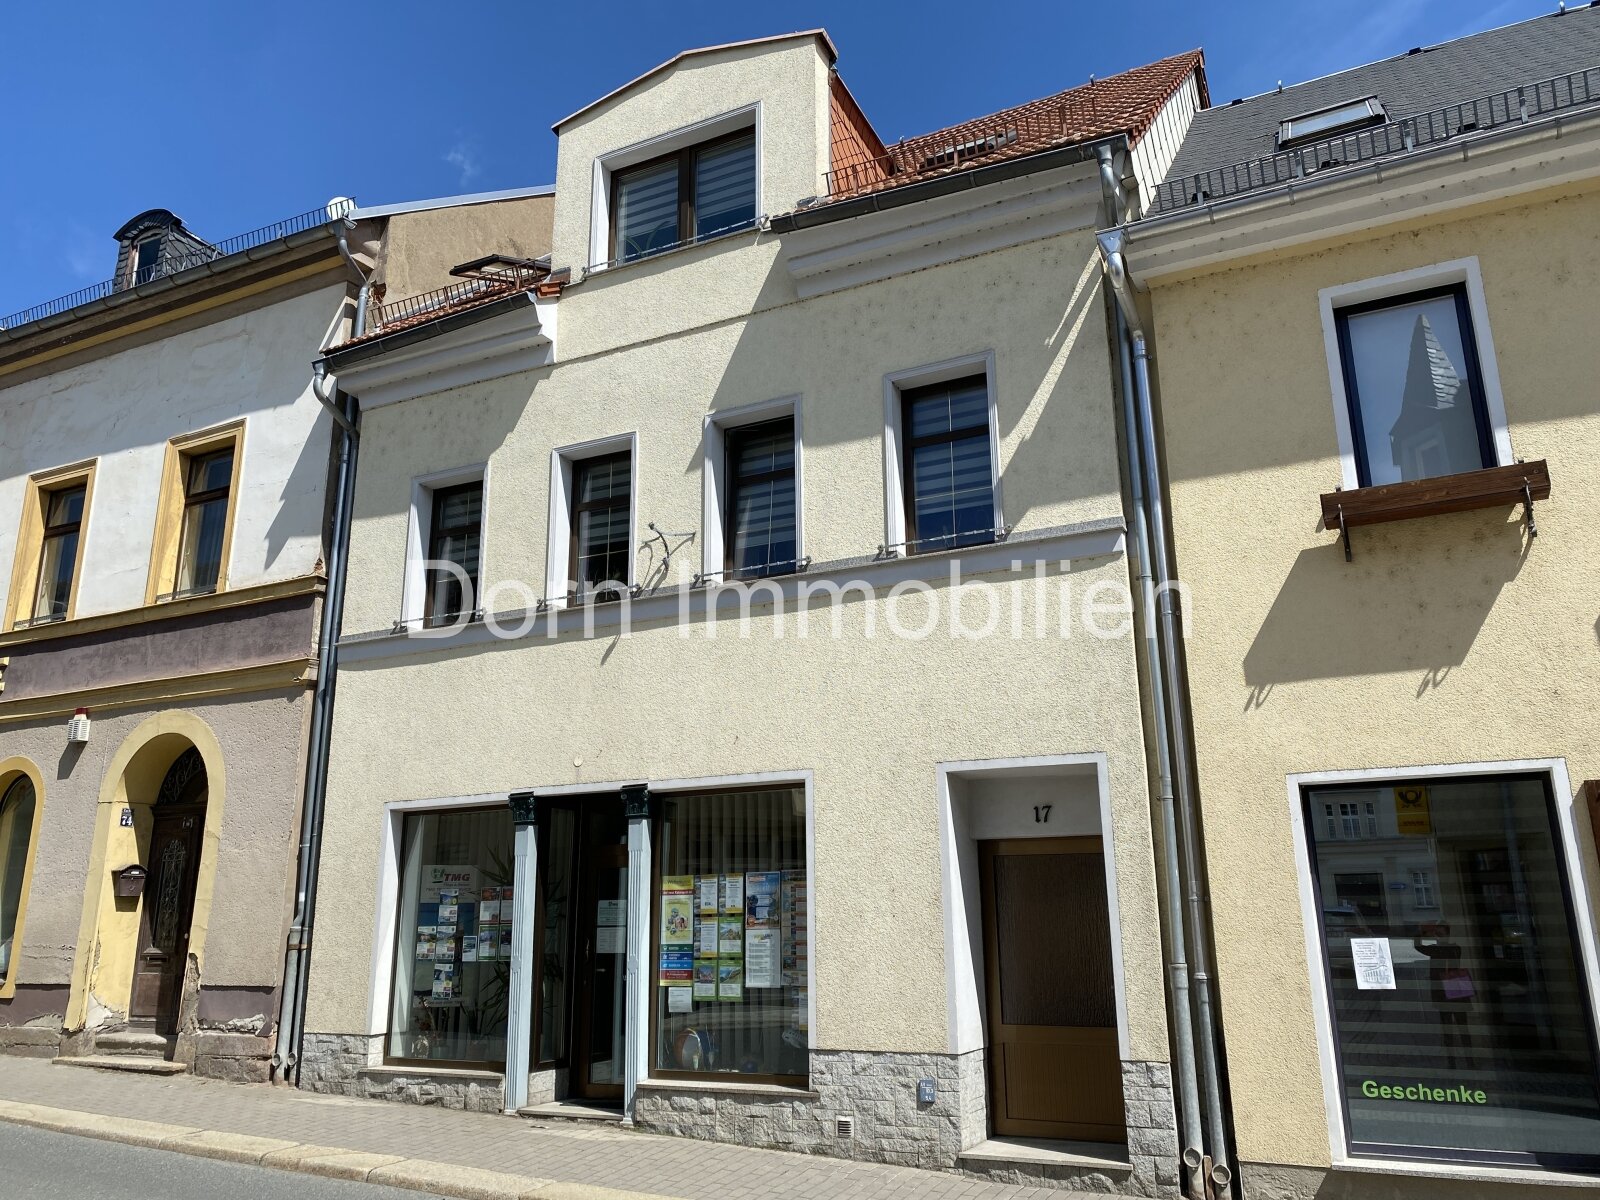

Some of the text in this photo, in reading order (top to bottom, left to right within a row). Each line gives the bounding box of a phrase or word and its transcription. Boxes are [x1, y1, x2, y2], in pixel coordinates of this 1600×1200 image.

[121, 815, 132, 826] 74
[1033, 805, 1052, 823] 17
[444, 873, 470, 882] TMG
[1362, 1080, 1487, 1104] Geschenke
